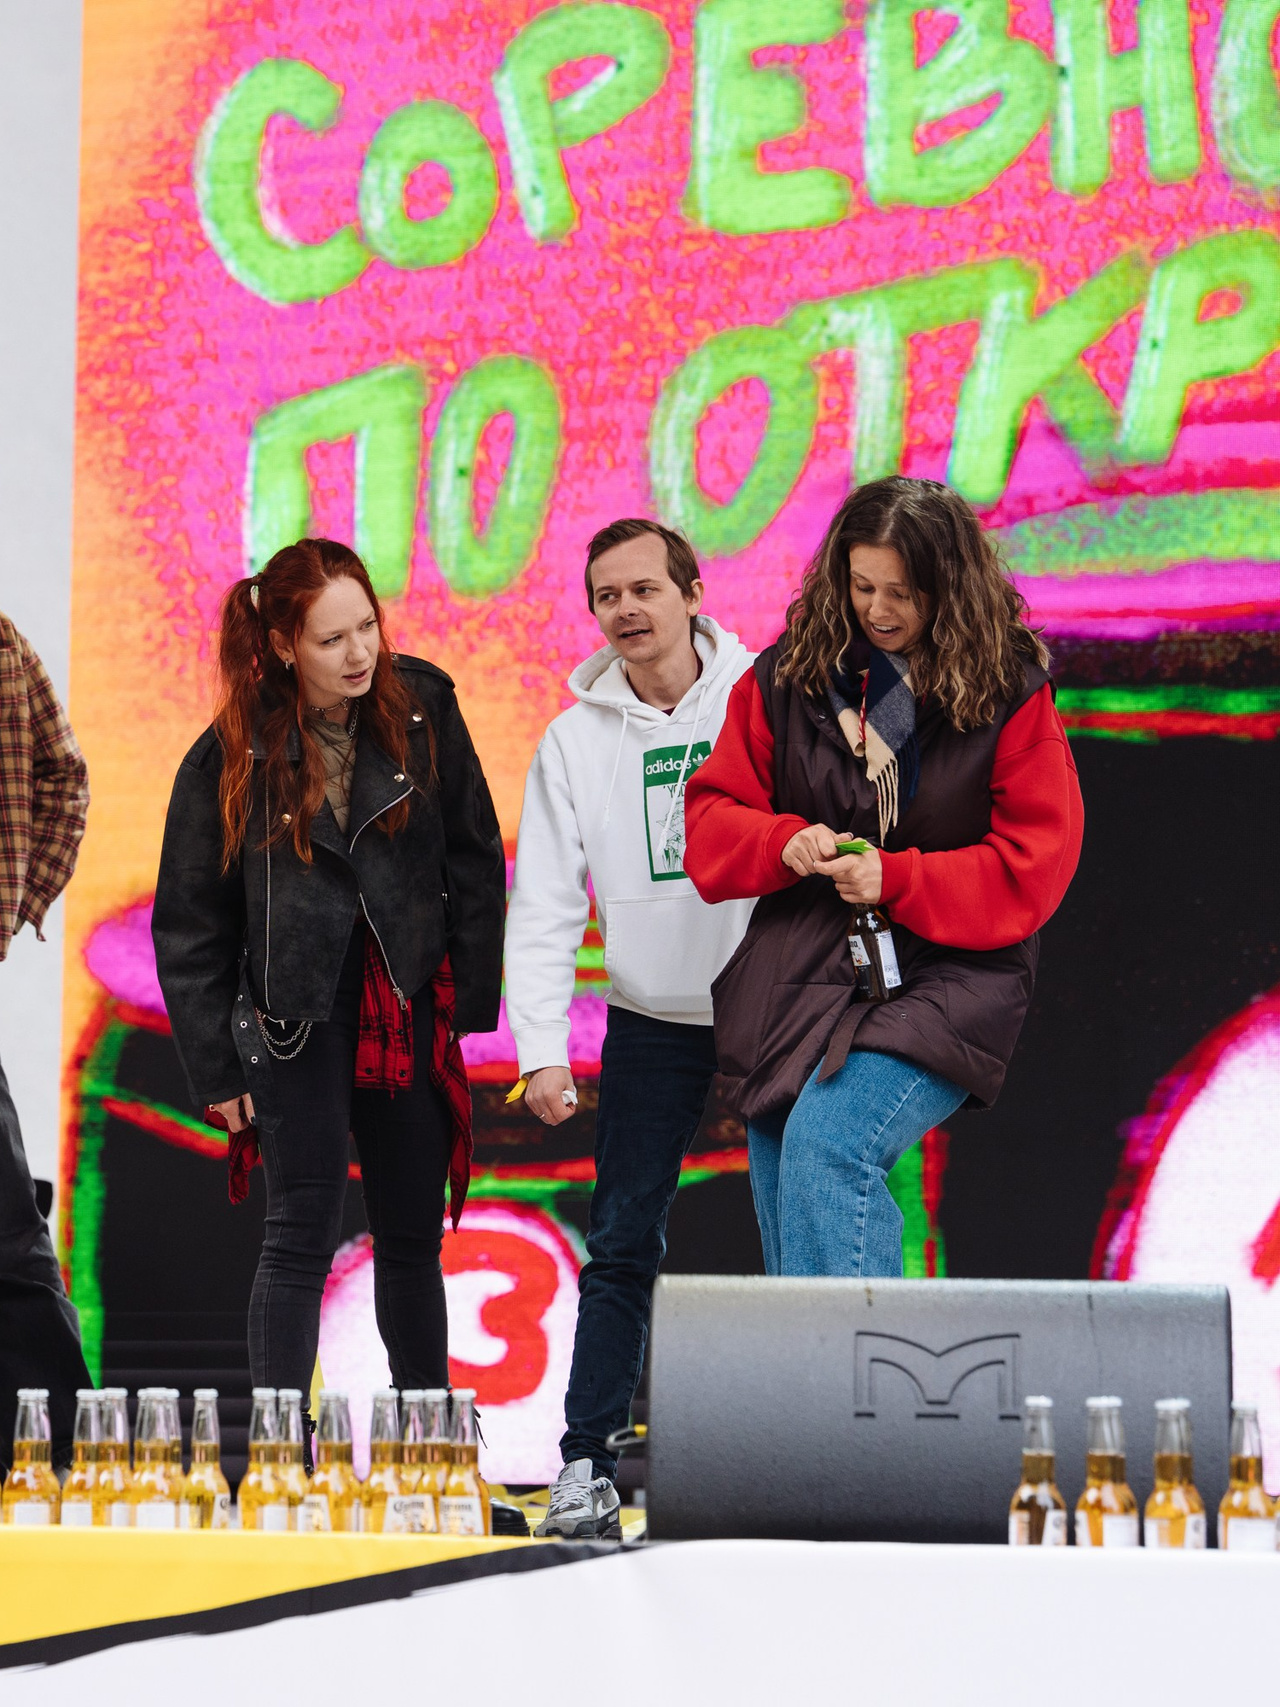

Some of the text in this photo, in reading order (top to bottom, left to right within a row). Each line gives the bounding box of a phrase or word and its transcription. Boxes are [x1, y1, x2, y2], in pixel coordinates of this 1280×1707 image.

[245, 353, 564, 600] ПО
[645, 757, 692, 775] adidas
[441, 1229, 559, 1406] 3
